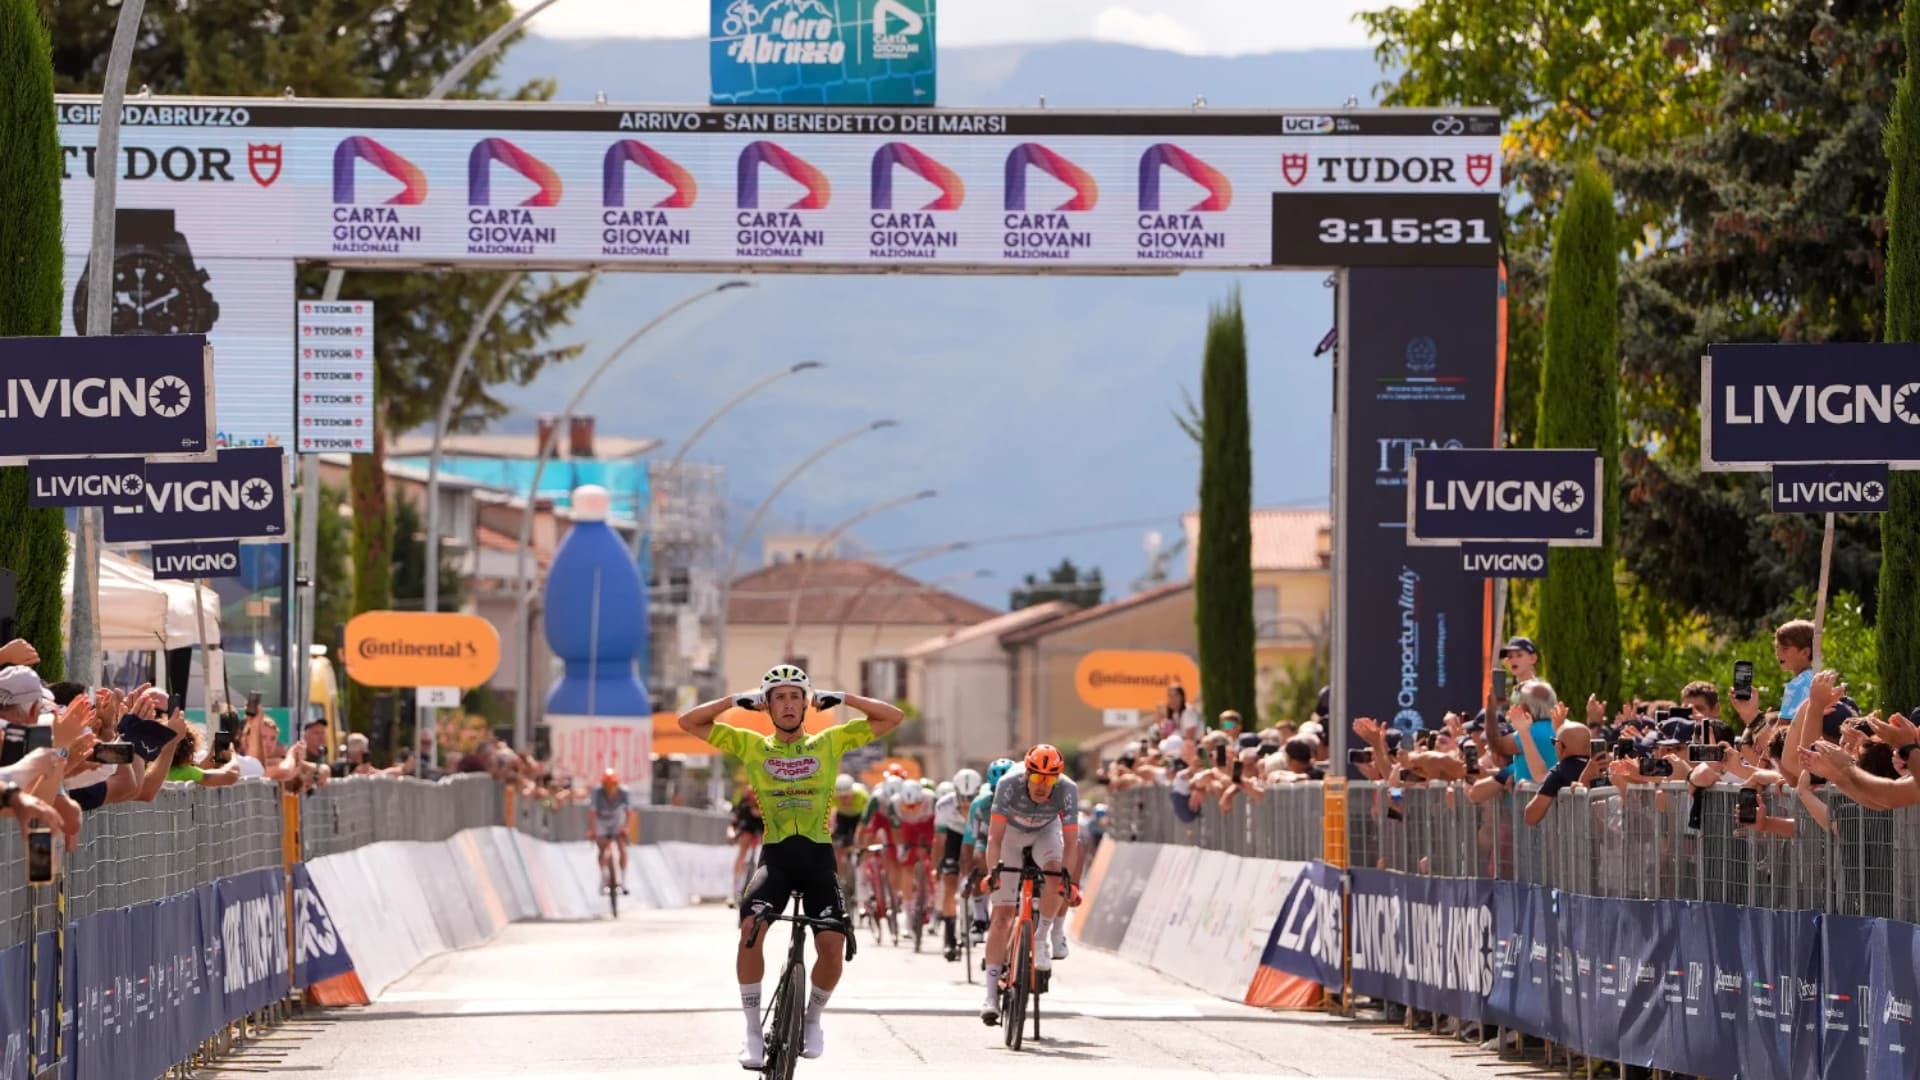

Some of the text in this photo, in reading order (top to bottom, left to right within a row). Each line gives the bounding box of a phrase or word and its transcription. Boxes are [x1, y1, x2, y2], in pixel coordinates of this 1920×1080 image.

[619, 113, 700, 129] ARRIVO
[723, 114, 769, 130] SAN
[773, 115, 896, 131] BENEDETTO
[901, 116, 933, 131] DEI
[939, 116, 1008, 132] MARSI
[1285, 119, 1314, 130] UCI
[1318, 157, 1456, 183] TUDOR
[334, 208, 398, 223] CARTA
[469, 209, 533, 224] CARTA
[603, 211, 667, 226] CARTA
[737, 212, 801, 227] CARTA
[871, 213, 935, 228] CARTA
[1005, 214, 1069, 229] CARTA
[1139, 215, 1203, 229] CARTA
[334, 226, 420, 242] GIOVANI
[469, 227, 556, 243] GIOVANI
[603, 229, 690, 244] GIOVANI
[737, 230, 824, 245] GIOVANI
[871, 231, 957, 246] GIOVANI
[1319, 218, 1491, 244] 3:15:31
[1004, 232, 1091, 247] GIOVANI
[1138, 233, 1225, 248] GIOVANI
[333, 243, 400, 252] NAZIONALE
[468, 245, 535, 254] NAZIONALE
[603, 246, 670, 256] NAZIONALE
[737, 247, 803, 257] NAZIONALE
[870, 248, 937, 258] NAZIONALE
[1004, 249, 1071, 258] NAZIONALE
[1138, 250, 1205, 259] NAZIONALE
[314, 305, 352, 314] TUDOR
[314, 327, 352, 336] TUDOR
[314, 349, 352, 358] TUDOR
[314, 372, 352, 380] TUDOR
[314, 394, 352, 404] TUDOR
[314, 417, 352, 426] TUDOR
[314, 439, 352, 448] TUDOR
[37, 474, 143, 497] LIVIGNO
[1778, 481, 1884, 503] LIVIGNO
[113, 478, 273, 514] VIGNO
[1426, 480, 1584, 513] LIVIGNO
[156, 552, 236, 572] LIVIGNO
[1464, 553, 1544, 571] LIVIGNO
[358, 638, 461, 659] Continental
